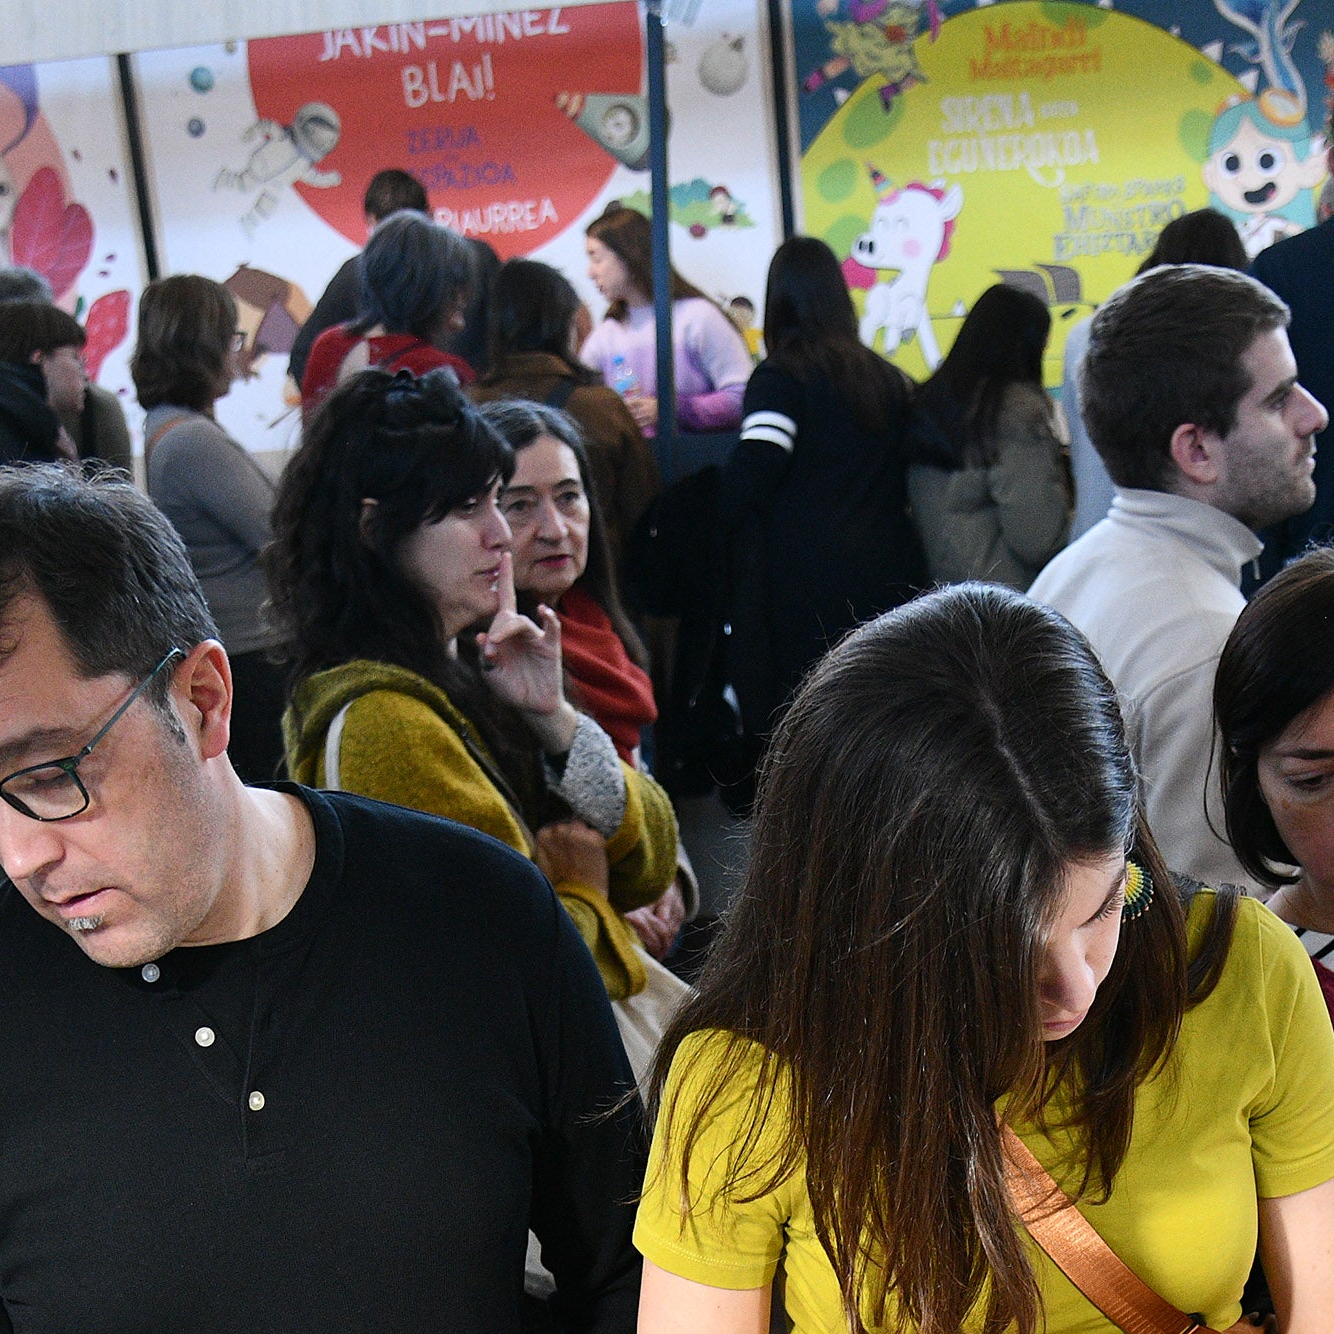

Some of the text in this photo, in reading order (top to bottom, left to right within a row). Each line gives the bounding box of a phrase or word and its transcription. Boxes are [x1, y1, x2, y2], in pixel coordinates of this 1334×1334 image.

[402, 52, 496, 109] BLAI!
[941, 91, 1035, 133] SIRENA
[927, 130, 1100, 182] EGUNEROKOA
